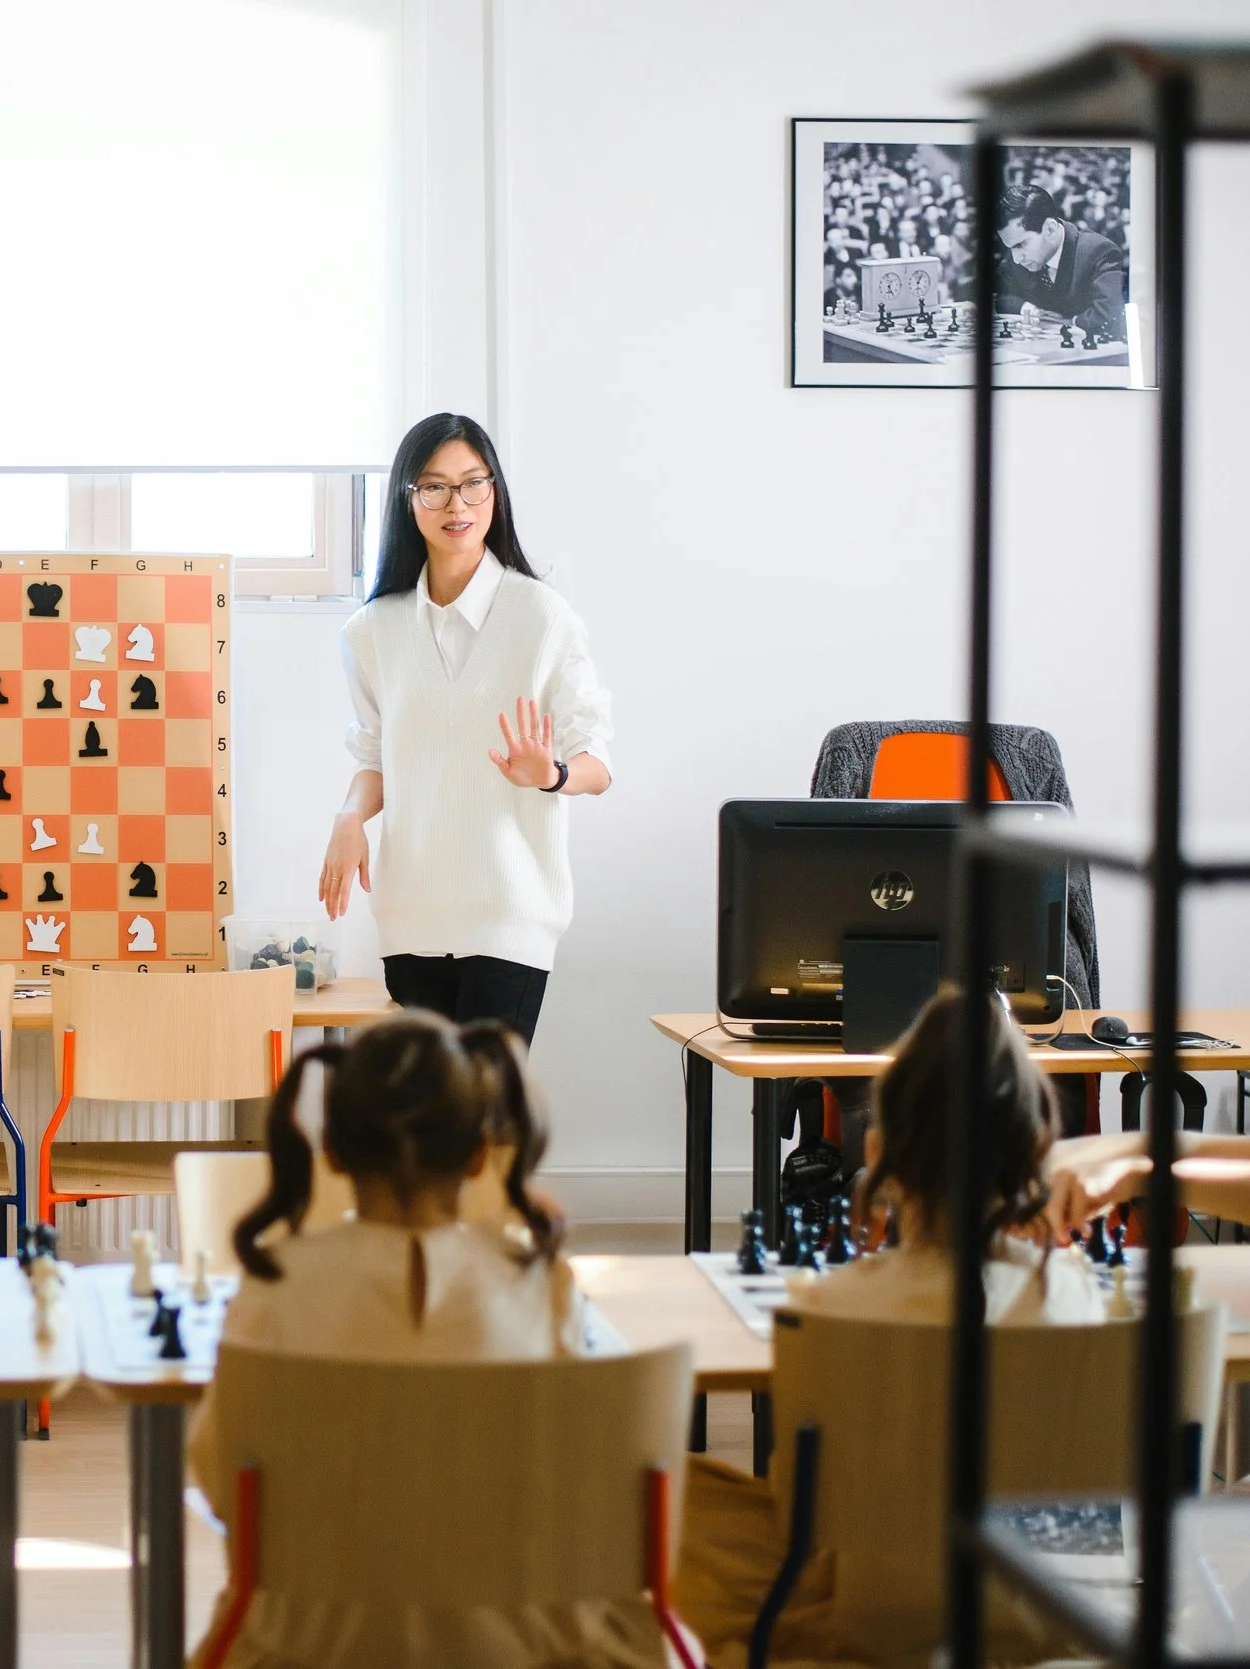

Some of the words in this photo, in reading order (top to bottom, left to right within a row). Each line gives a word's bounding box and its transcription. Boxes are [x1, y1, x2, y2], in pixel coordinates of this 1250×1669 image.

[40, 559, 50, 571] E
[90, 559, 99, 571] F
[135, 559, 146, 572] G
[184, 560, 193, 572] H
[217, 593, 227, 608] 8
[217, 640, 227, 654] 7
[217, 690, 227, 705] 6
[217, 737, 227, 752] 5
[217, 783, 227, 798] 4
[217, 832, 227, 846] 3
[217, 881, 227, 895] 2
[218, 927, 226, 942] 1
[41, 964, 51, 976] E
